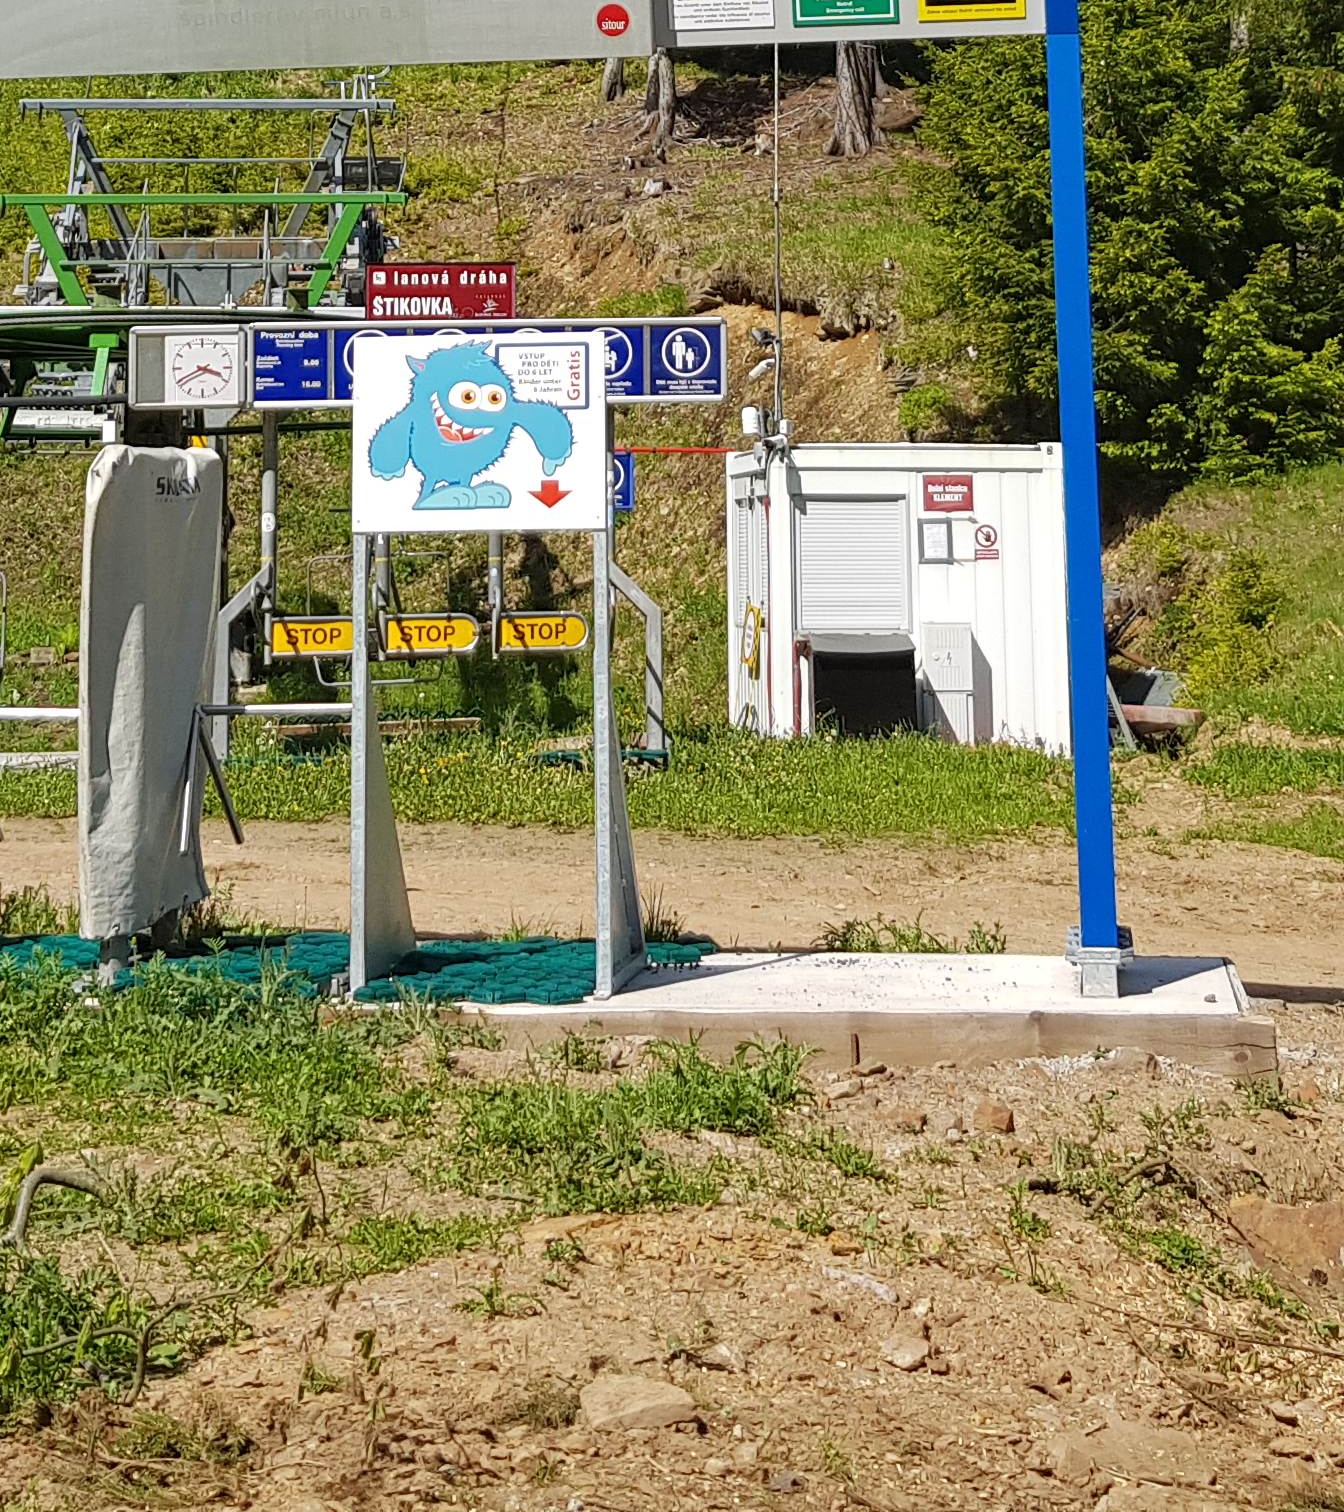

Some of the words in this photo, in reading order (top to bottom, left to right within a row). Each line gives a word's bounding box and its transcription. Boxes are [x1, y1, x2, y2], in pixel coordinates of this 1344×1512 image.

[601, 17, 625, 29] sitour
[394, 270, 449, 285] lanová
[459, 270, 507, 284] dráha
[372, 295, 452, 316] ŠTIKOVKA
[541, 359, 559, 367] DĚTI
[567, 351, 580, 400] Gratis
[286, 627, 342, 646] STOP
[400, 625, 456, 643] STOP
[513, 622, 567, 640] STOP
